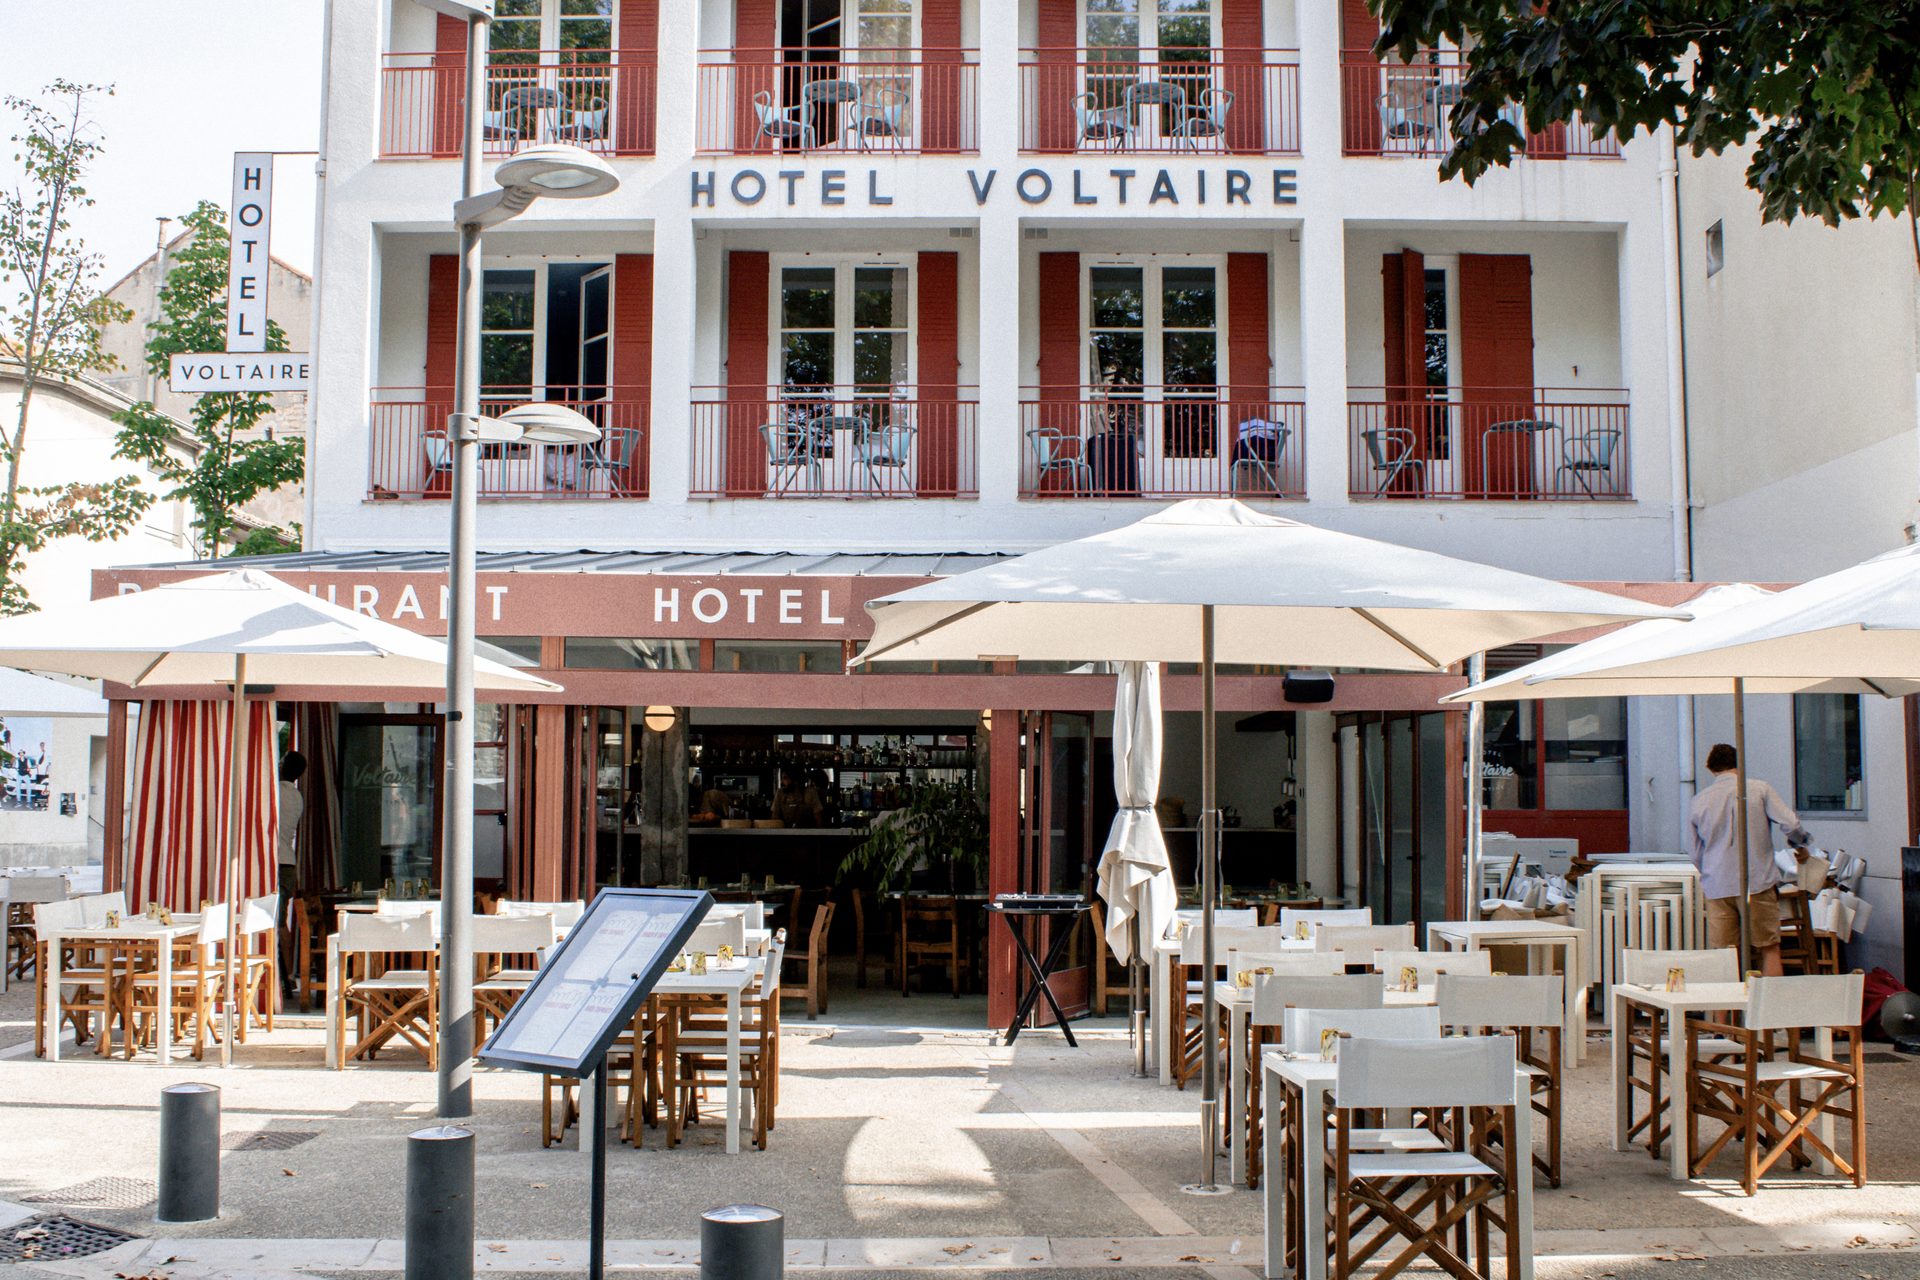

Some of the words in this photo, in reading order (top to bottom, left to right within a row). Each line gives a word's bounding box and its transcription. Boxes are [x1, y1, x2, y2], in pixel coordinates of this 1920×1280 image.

[691, 169, 893, 207] HOTEL
[966, 168, 1297, 206] VOLTAIRE
[238, 168, 264, 336] HOTEL
[181, 364, 310, 380] VOLTAIRE
[654, 587, 845, 624] HOTEL
